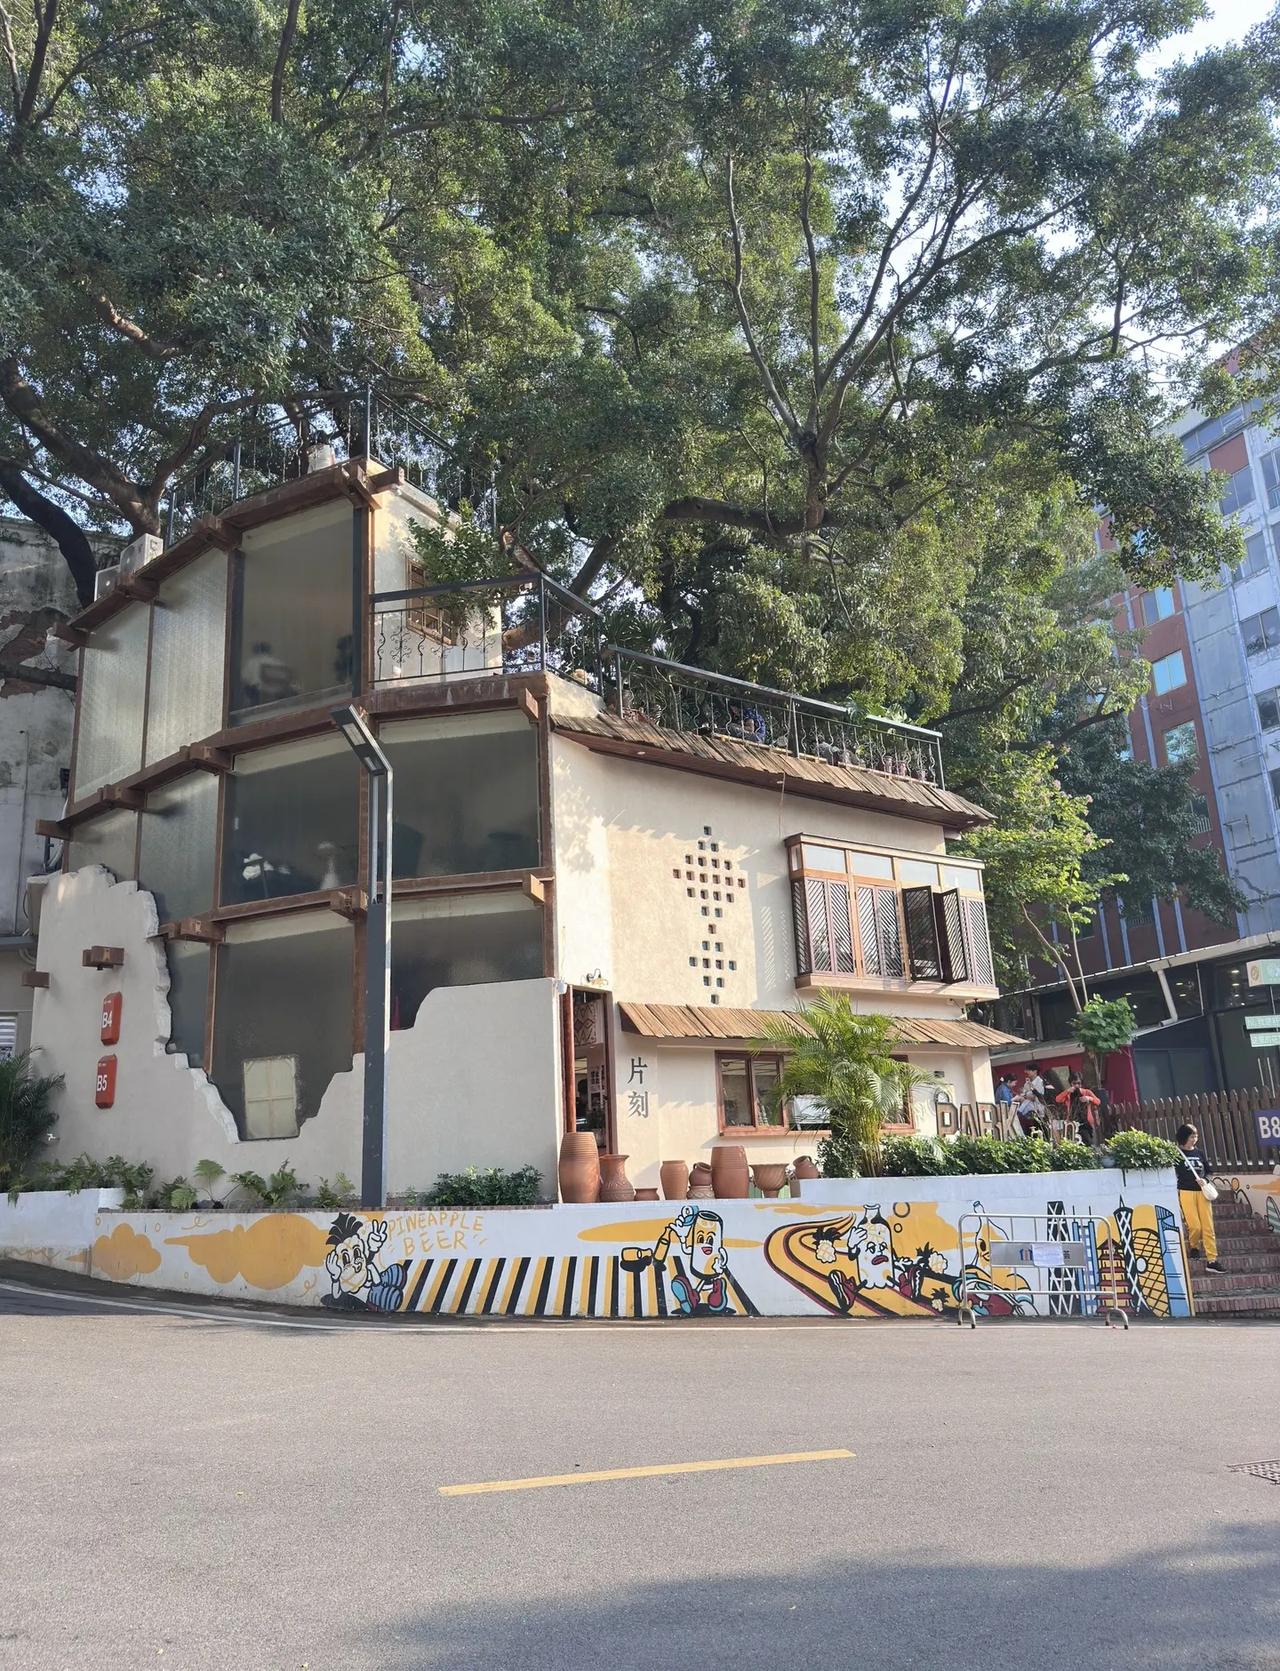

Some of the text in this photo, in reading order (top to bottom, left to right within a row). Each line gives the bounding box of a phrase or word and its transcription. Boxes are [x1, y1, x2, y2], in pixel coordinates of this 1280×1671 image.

[102, 1011, 113, 1028] B4
[96, 1075, 108, 1091] B5
[627, 1056, 649, 1119] 片刻
[935, 1100, 1025, 1141] PARK
[1258, 1116, 1280, 1139] B8
[388, 1211, 484, 1241] PINEAPPLE
[403, 1230, 468, 1257] BEER
